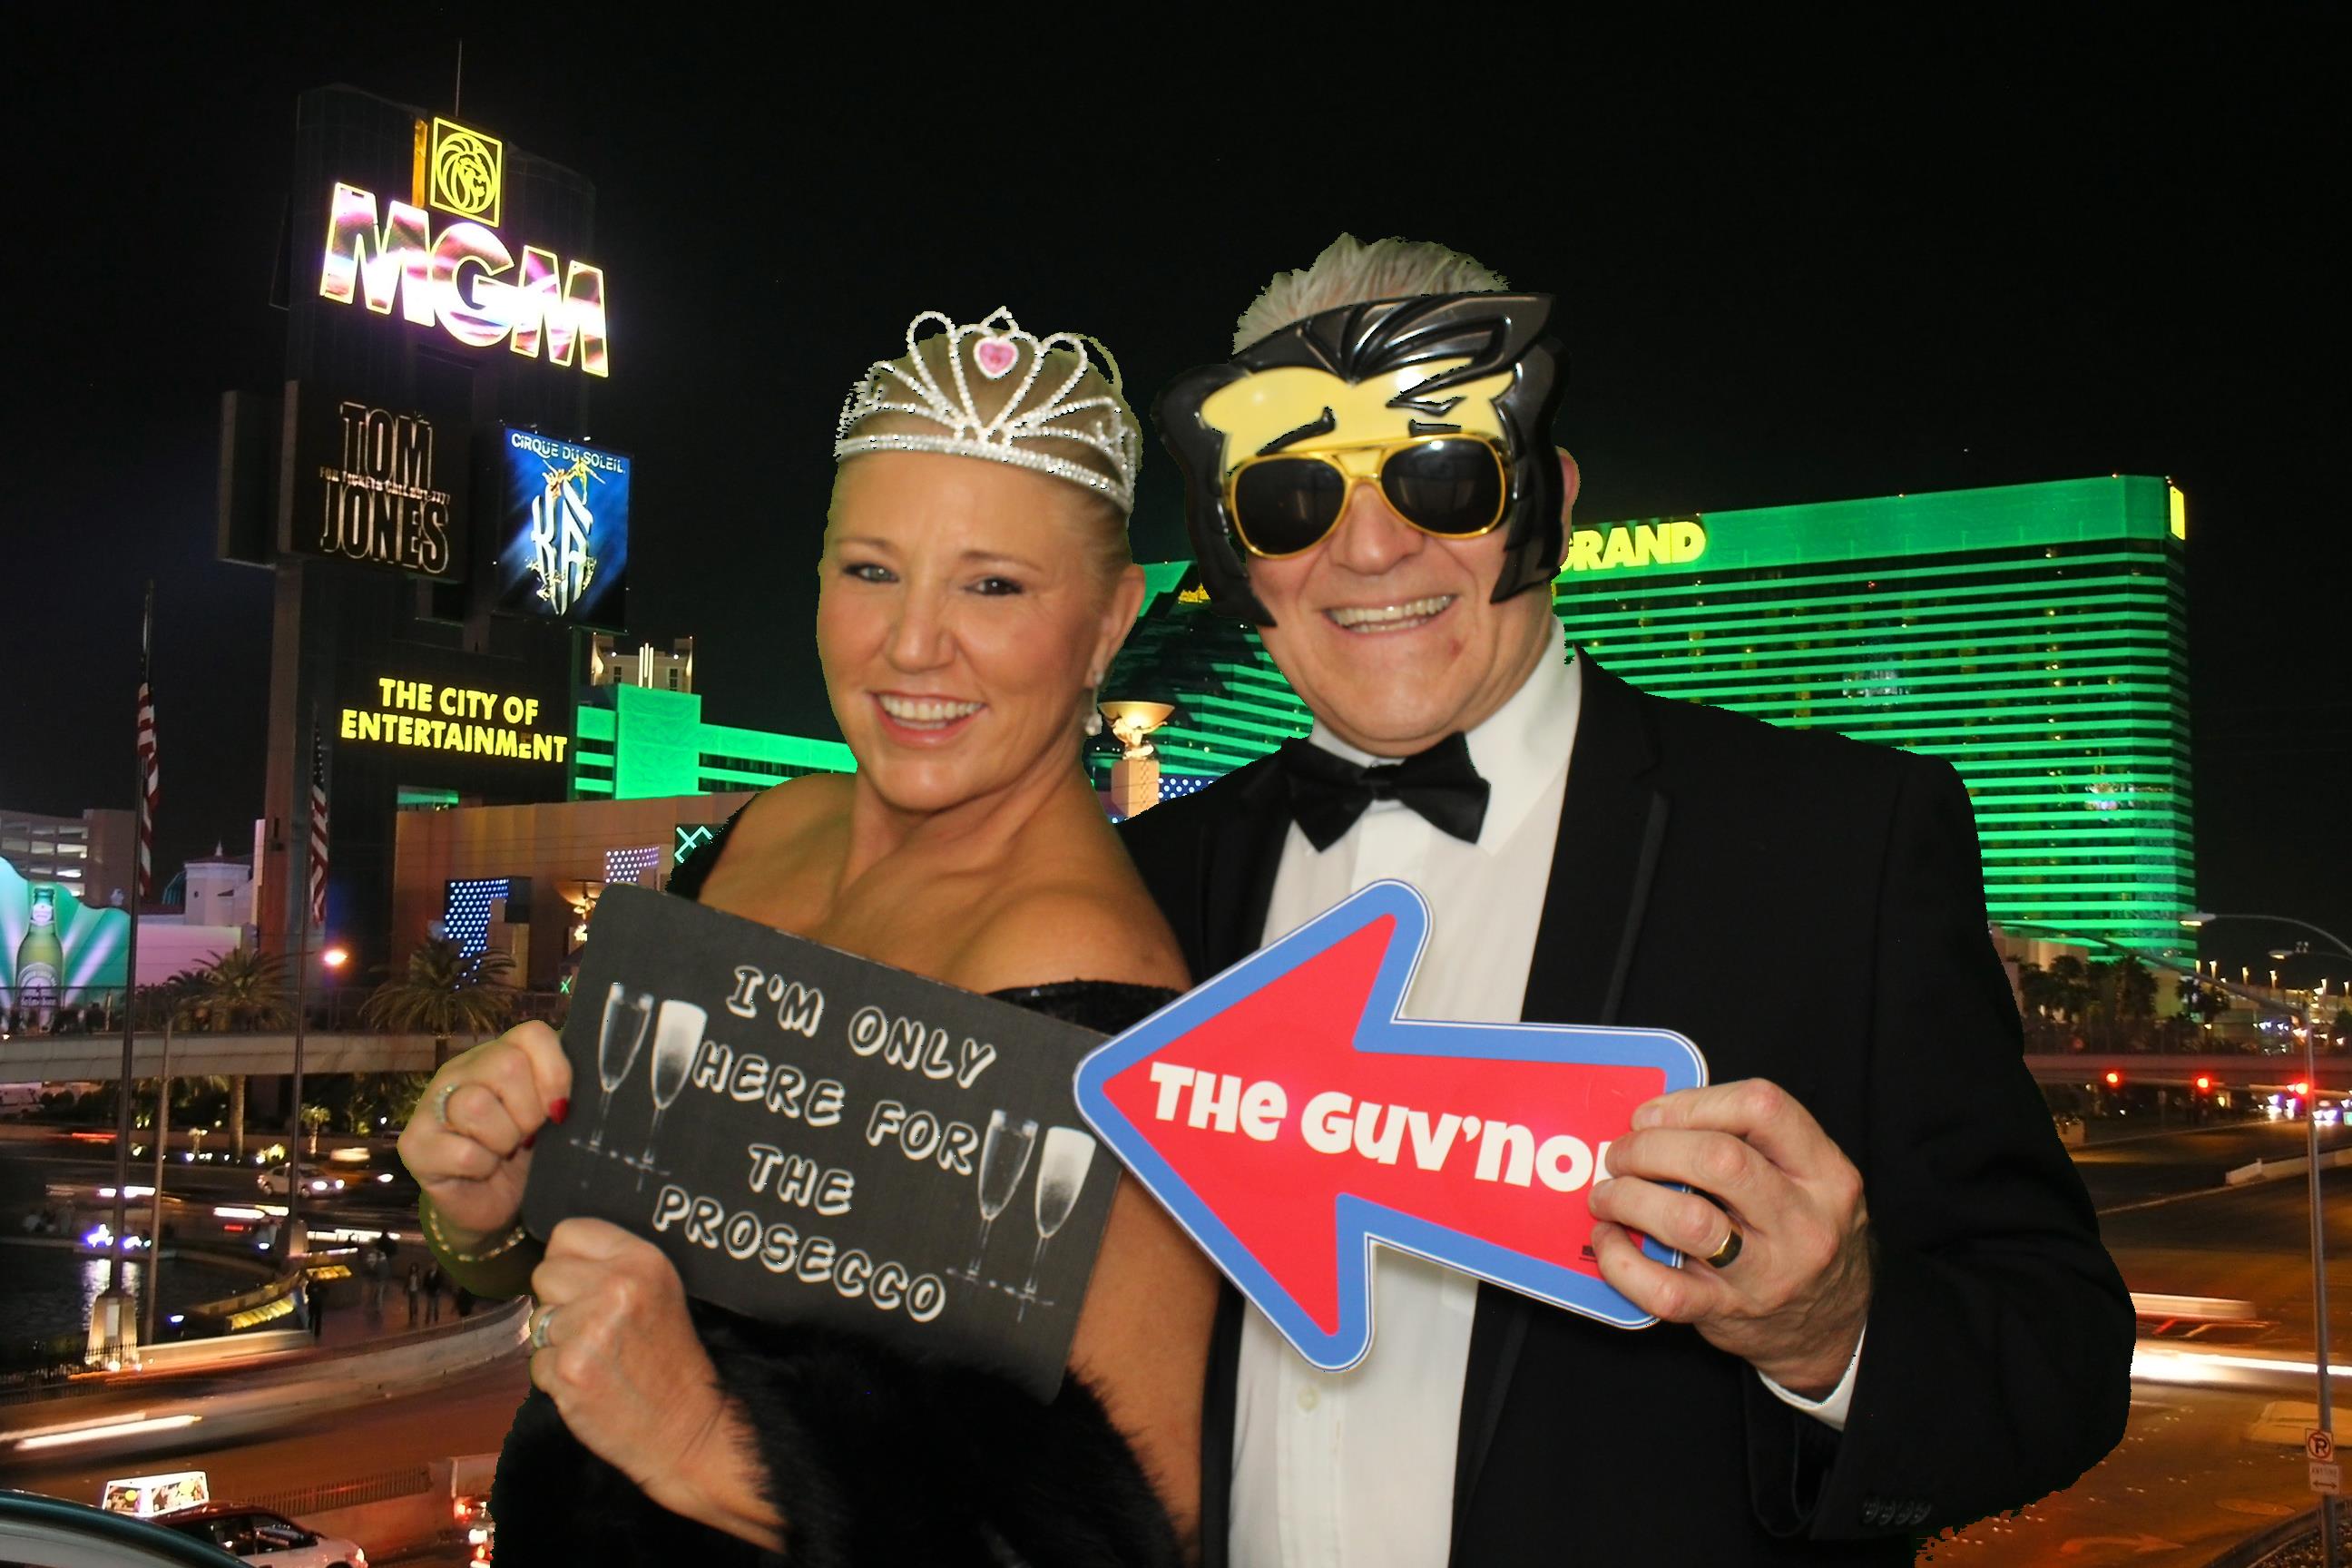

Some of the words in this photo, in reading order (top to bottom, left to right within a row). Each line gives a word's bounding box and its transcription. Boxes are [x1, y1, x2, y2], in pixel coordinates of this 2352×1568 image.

[320, 182, 609, 377] MGM
[339, 401, 433, 490] TOM
[511, 433, 559, 458] CIRQUE
[562, 446, 580, 462] DU
[580, 451, 624, 474] SOLEIL
[320, 481, 449, 573] JONES
[340, 709, 568, 762] ENTERTAINMENT
[378, 677, 433, 712] THE
[439, 687, 498, 720] CITY
[503, 696, 539, 725] OF
[725, 965, 825, 1038] I'M
[848, 1005, 997, 1089] ONLY
[691, 1039, 845, 1126] HERE
[866, 1099, 979, 1176] FOR
[747, 1142, 855, 1216] THE
[652, 1183, 946, 1323] PROSECCO
